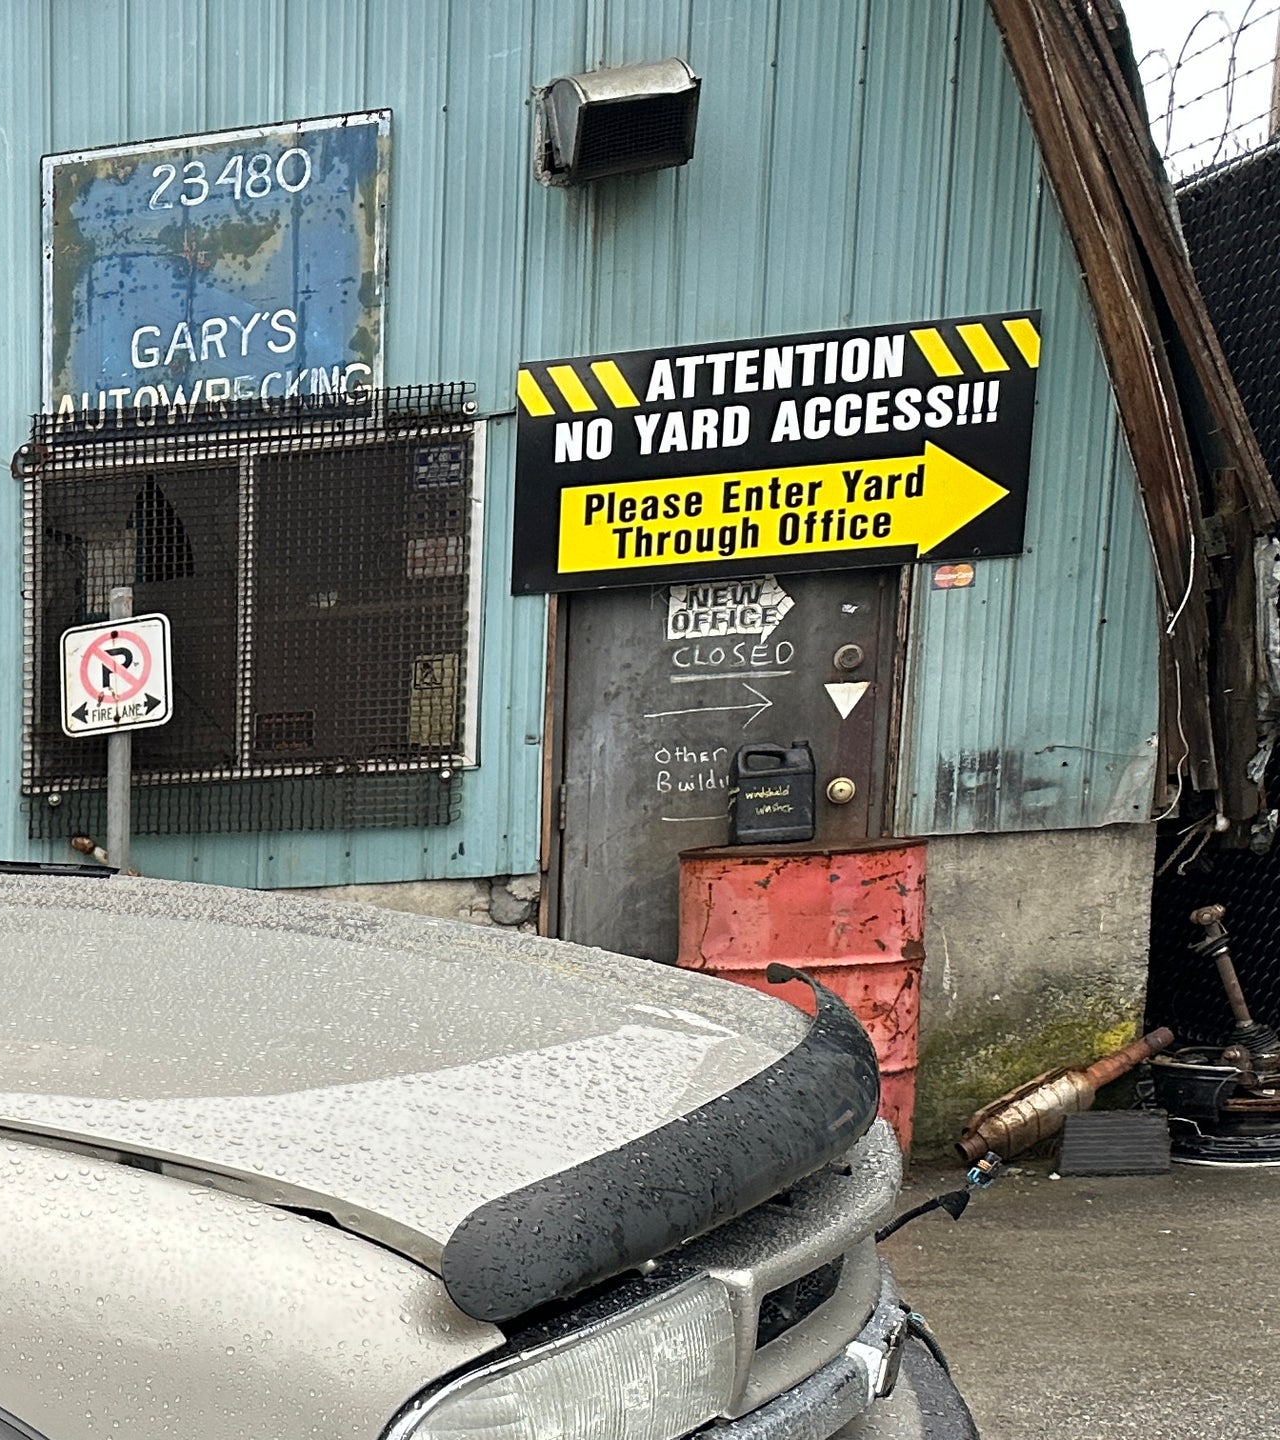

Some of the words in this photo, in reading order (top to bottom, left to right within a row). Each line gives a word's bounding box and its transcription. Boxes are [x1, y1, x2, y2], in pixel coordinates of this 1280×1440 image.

[149, 148, 312, 211] 23480
[131, 308, 298, 370] GARY'S
[645, 334, 906, 403] ATTENTION
[554, 418, 613, 463] NO
[635, 405, 750, 455] YARD
[769, 380, 1001, 444] ACCESS!!!
[584, 488, 704, 526] Please
[723, 476, 819, 515] Enter
[842, 464, 926, 502] Yard
[612, 517, 760, 560] Through
[778, 510, 891, 547] Office
[671, 607, 780, 633] OFFICE
[689, 583, 763, 608] NEW
[672, 641, 795, 668] CLOSED
[91, 707, 113, 723] FIRE
